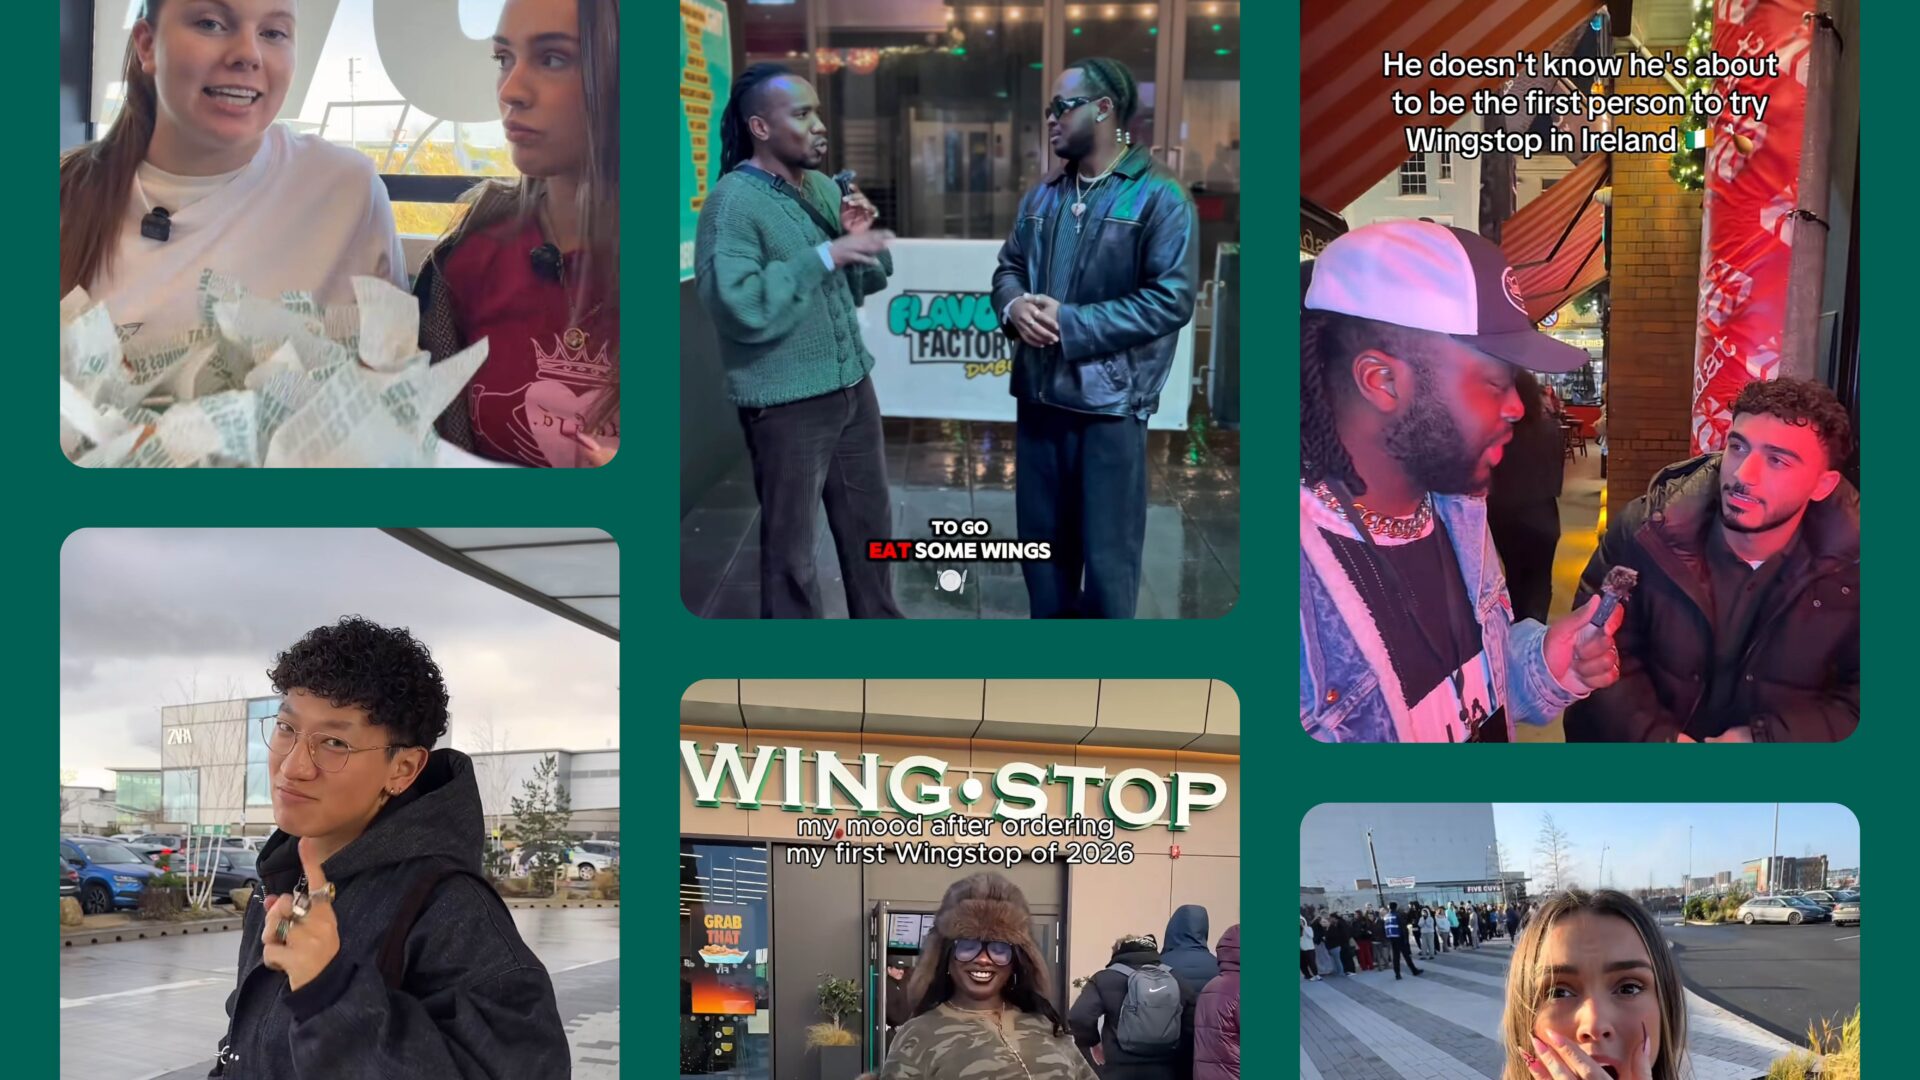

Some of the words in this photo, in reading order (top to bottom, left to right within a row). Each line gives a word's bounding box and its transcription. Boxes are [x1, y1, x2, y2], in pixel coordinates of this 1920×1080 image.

[888, 294, 999, 335] FLAVO
[918, 330, 1010, 359] FACTOR
[167, 728, 192, 745] ZARA
[704, 914, 742, 929] GRAB
[706, 929, 741, 945] THAT
